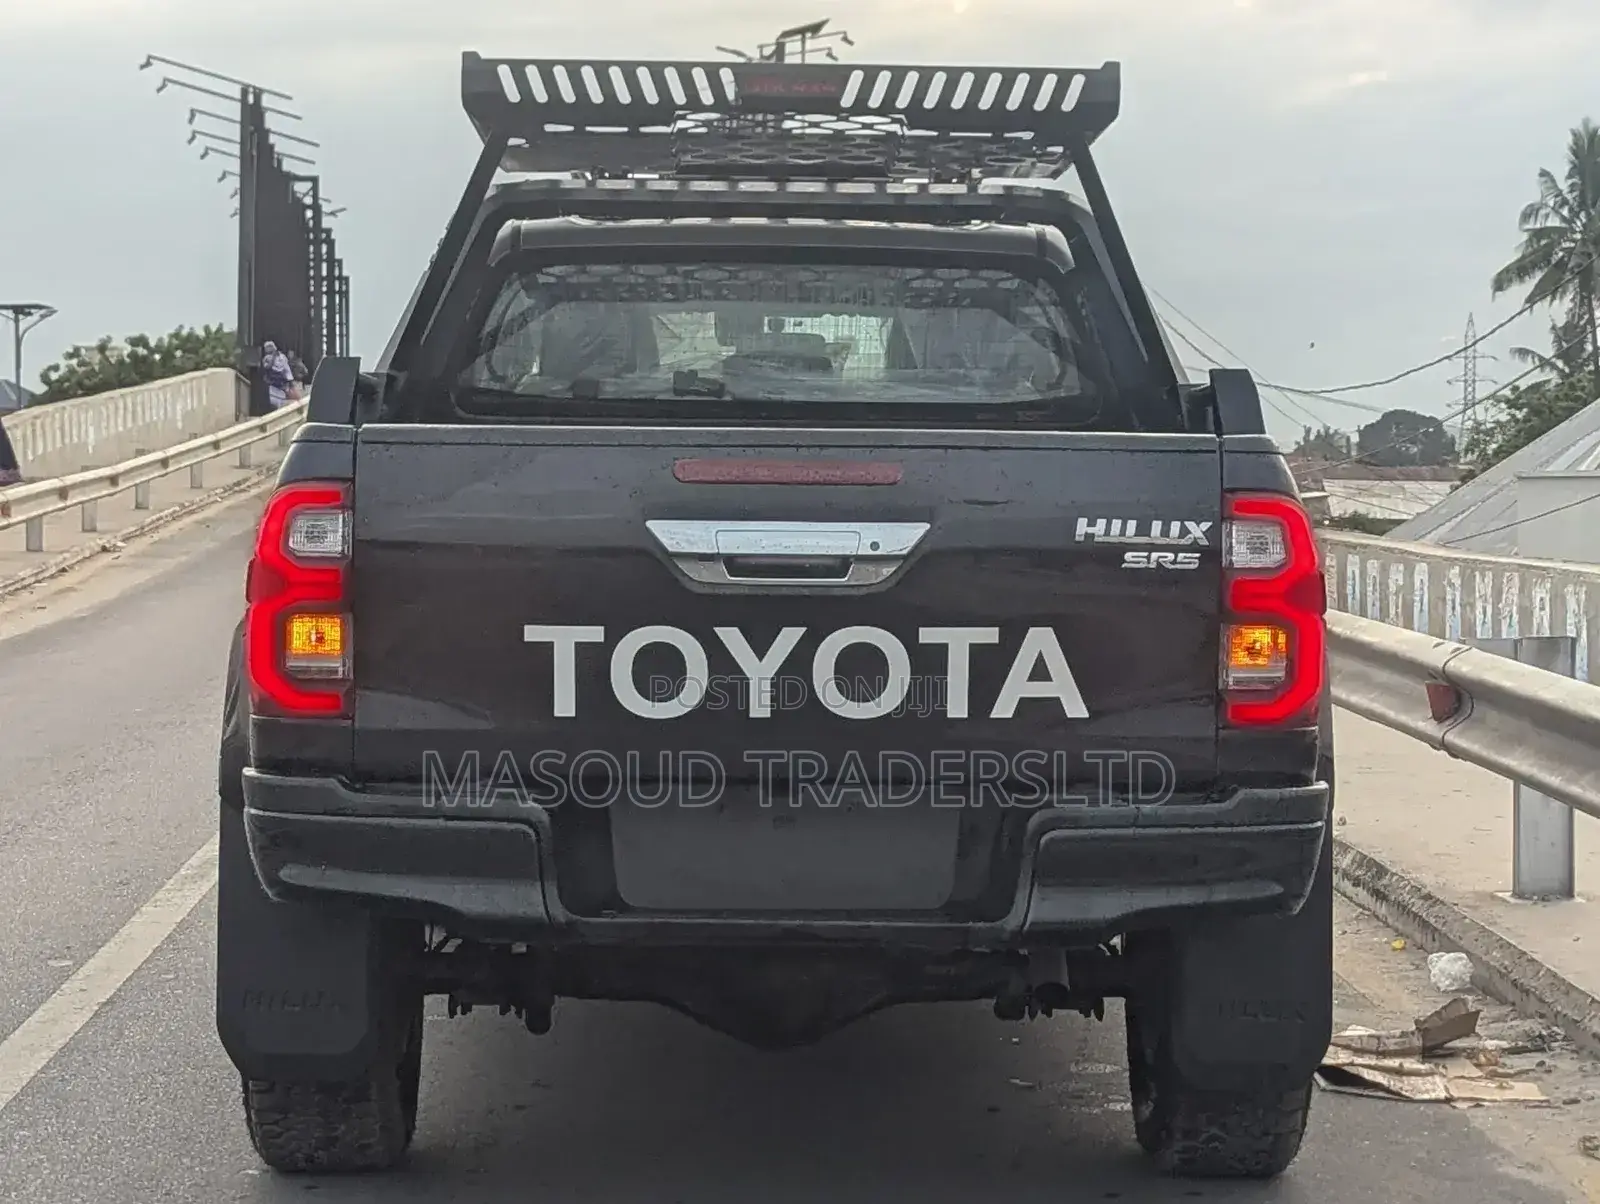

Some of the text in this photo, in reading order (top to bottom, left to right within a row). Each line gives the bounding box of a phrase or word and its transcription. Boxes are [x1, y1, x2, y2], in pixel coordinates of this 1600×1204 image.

[1074, 517, 1213, 546] HILUX
[1121, 551, 1201, 570] SR5
[523, 624, 1090, 719] TOYOTA
